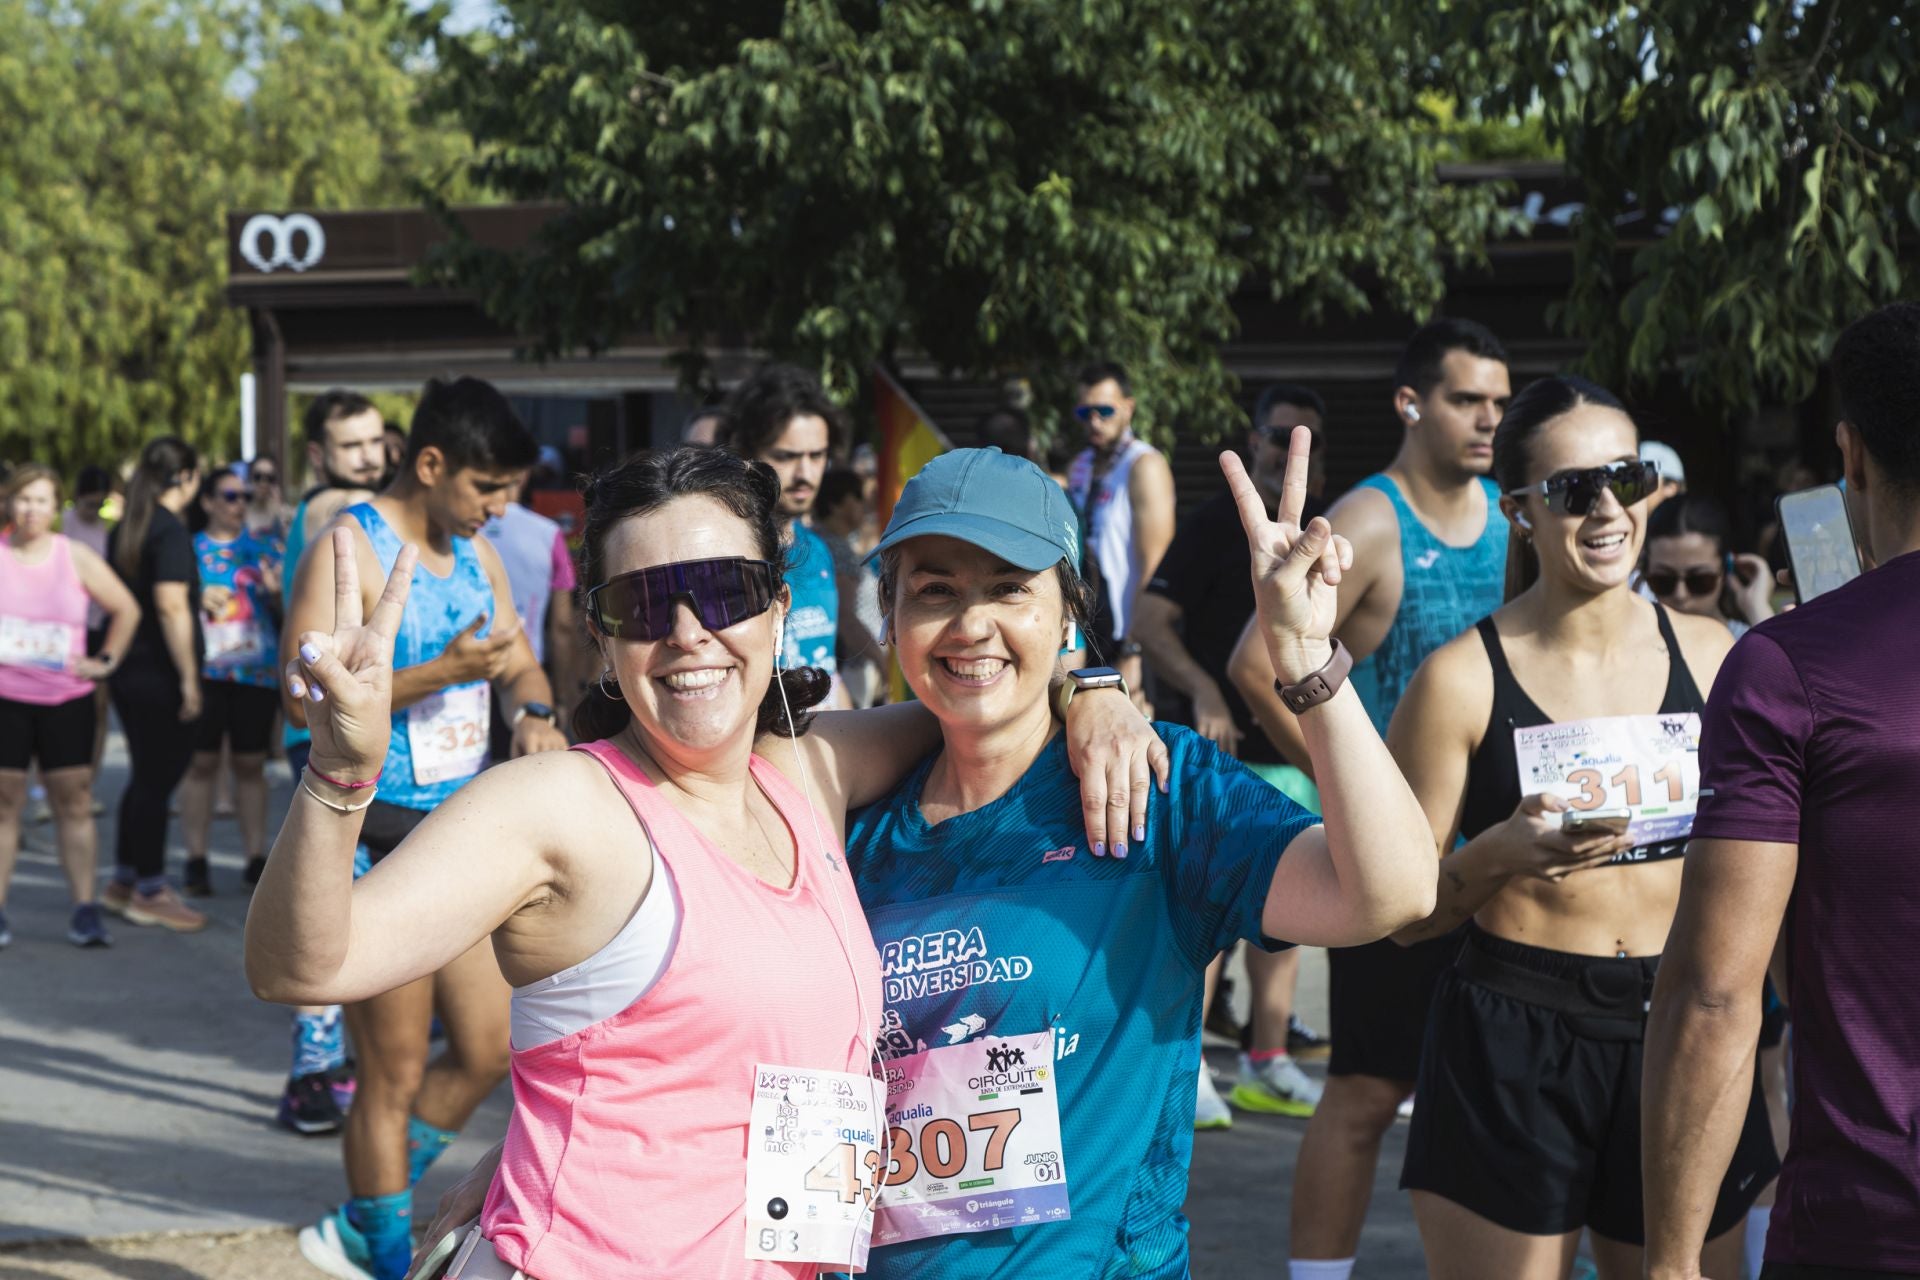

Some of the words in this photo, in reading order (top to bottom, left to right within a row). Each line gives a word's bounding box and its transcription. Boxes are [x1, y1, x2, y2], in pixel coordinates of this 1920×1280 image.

[1581, 752, 1622, 768] aqualia
[1566, 760, 1684, 811] 311
[881, 926, 987, 976] RRERA
[885, 956, 1033, 1003] DIVERSIDAD
[759, 1071, 776, 1090] IX
[889, 1104, 933, 1124] aqualia
[1024, 1151, 1058, 1165] JUNIO
[1034, 1162, 1061, 1182] 01
